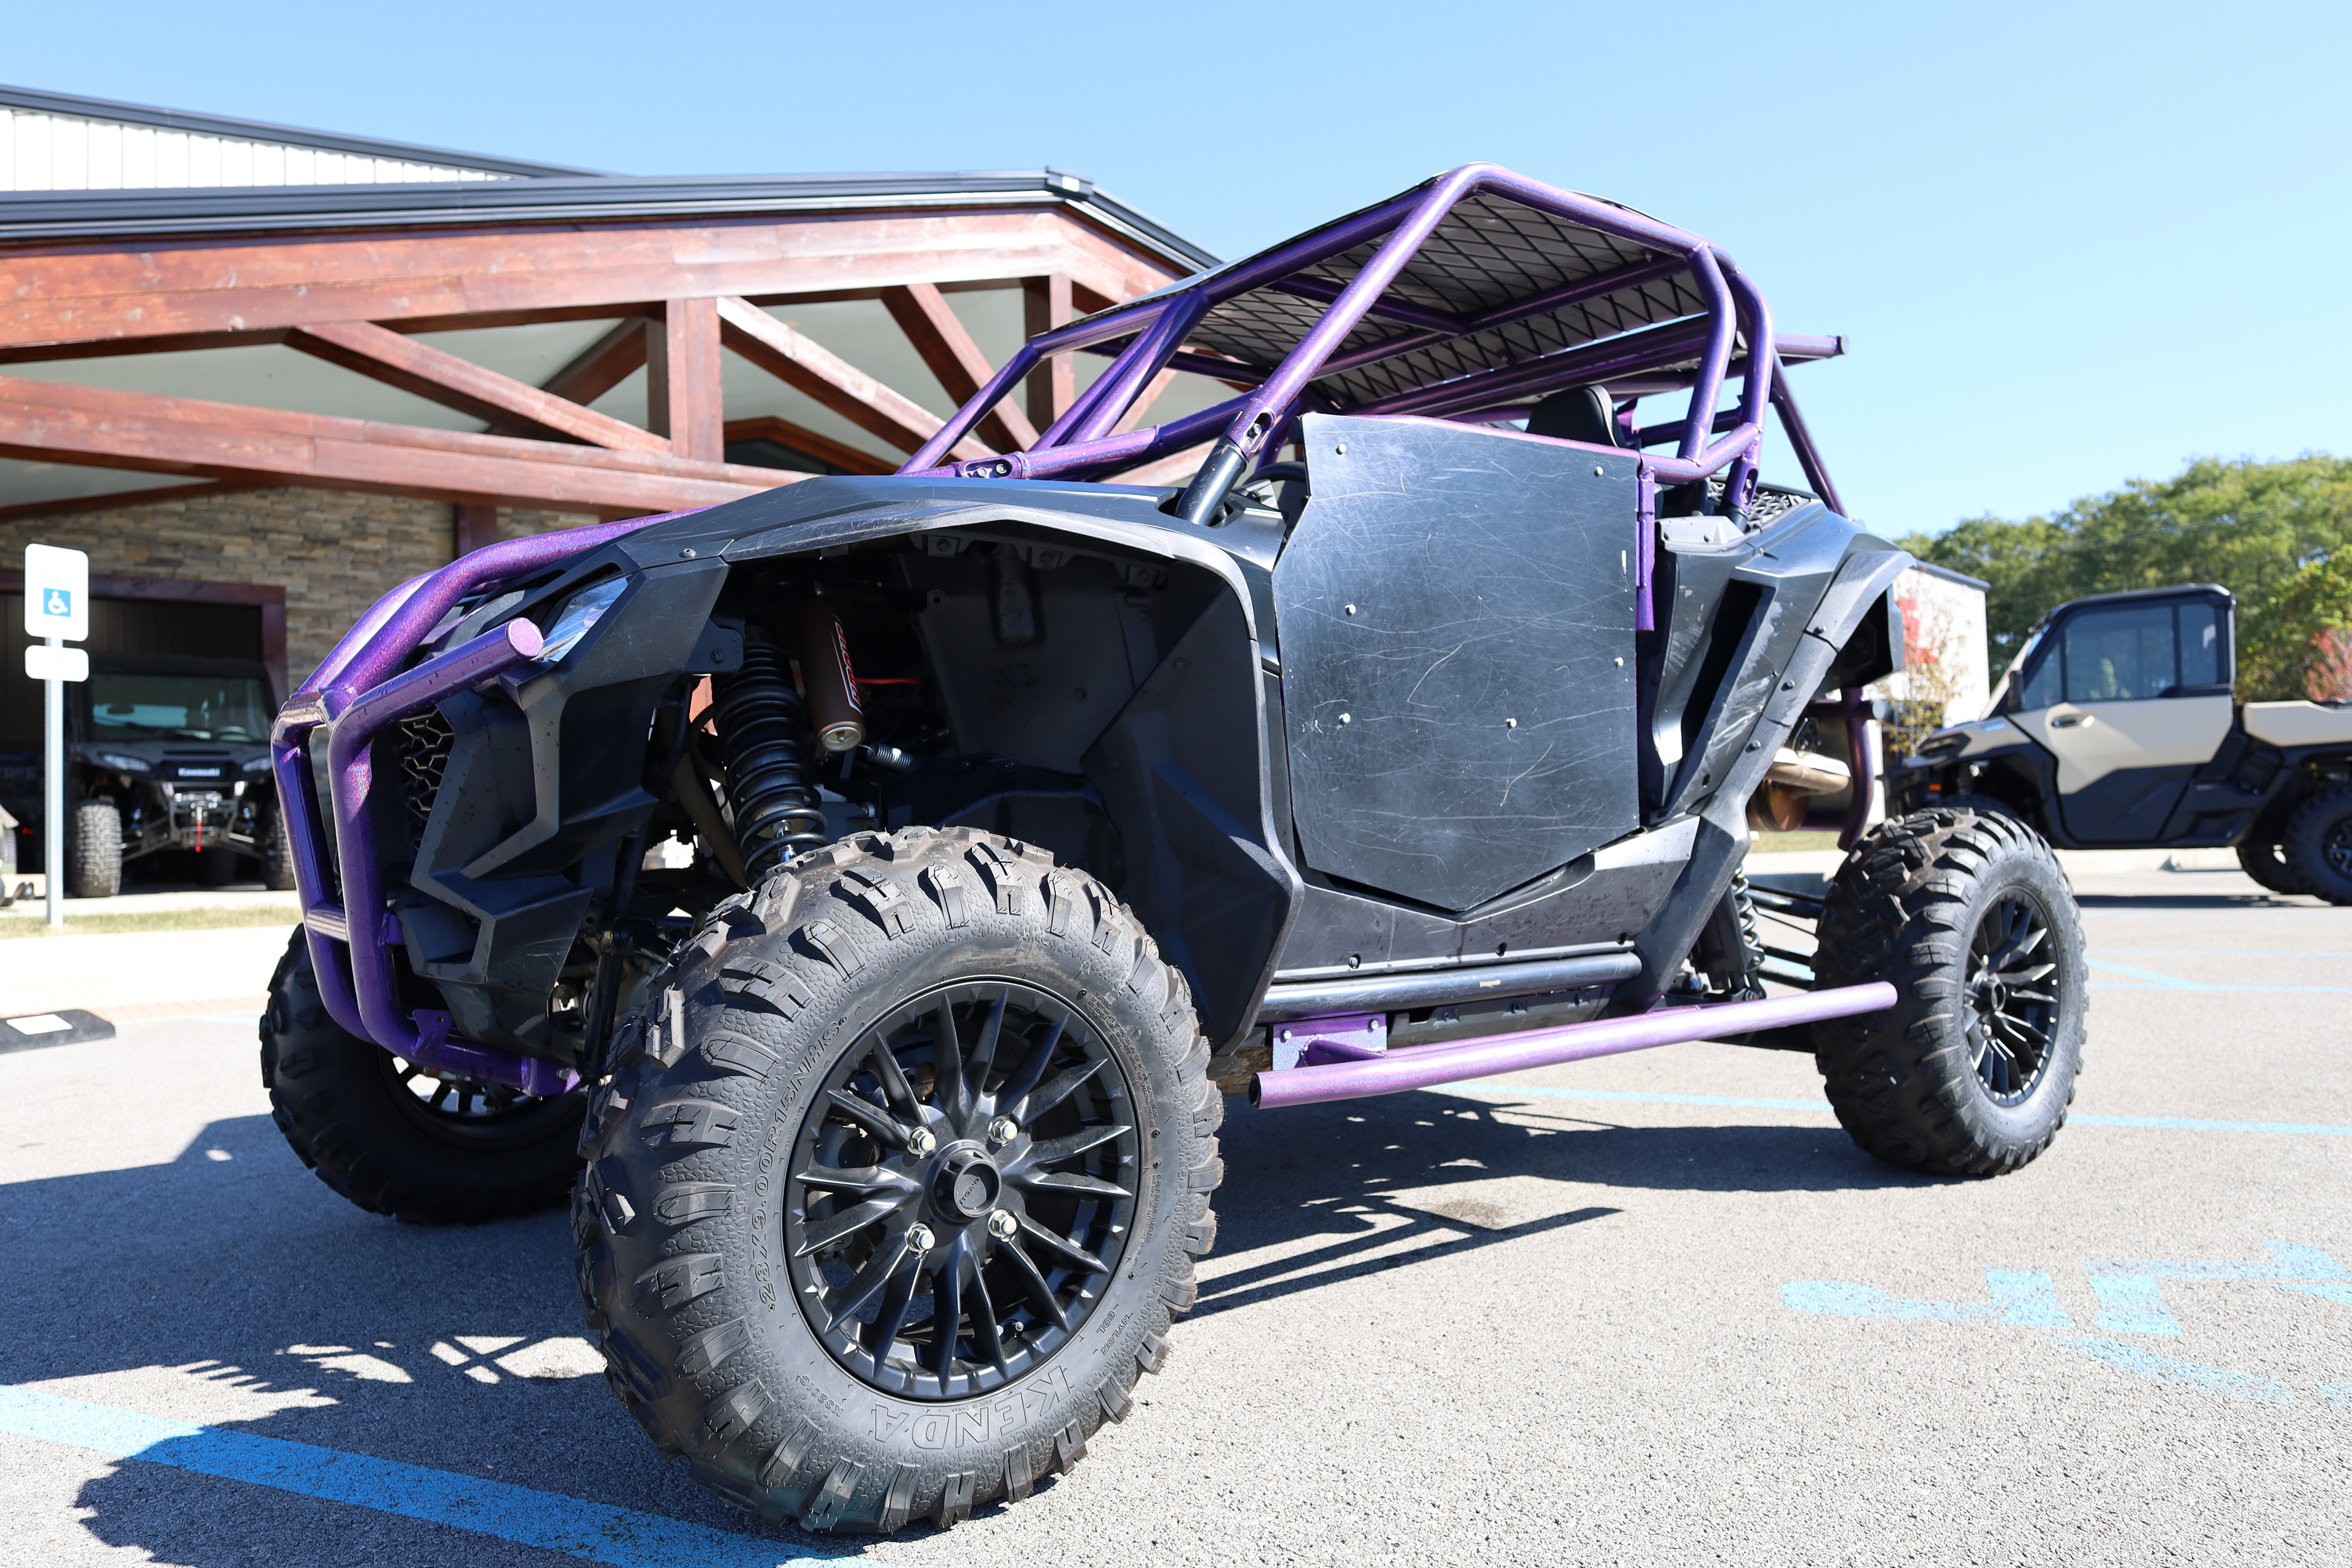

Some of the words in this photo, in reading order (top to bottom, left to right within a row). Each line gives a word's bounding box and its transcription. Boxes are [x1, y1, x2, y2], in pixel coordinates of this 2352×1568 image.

[178, 767, 220, 777] Kawasaki
[1095, 991, 1111, 1009] WARNING
[1145, 1216, 1156, 1243] TUBELESS
[1096, 1311, 1115, 1333] 69L
[1101, 1313, 1130, 1355] NYLON
[874, 1365, 1072, 1450] KENDA
[951, 1404, 970, 1413] TAIWAN
[980, 1399, 993, 1407] MADE
